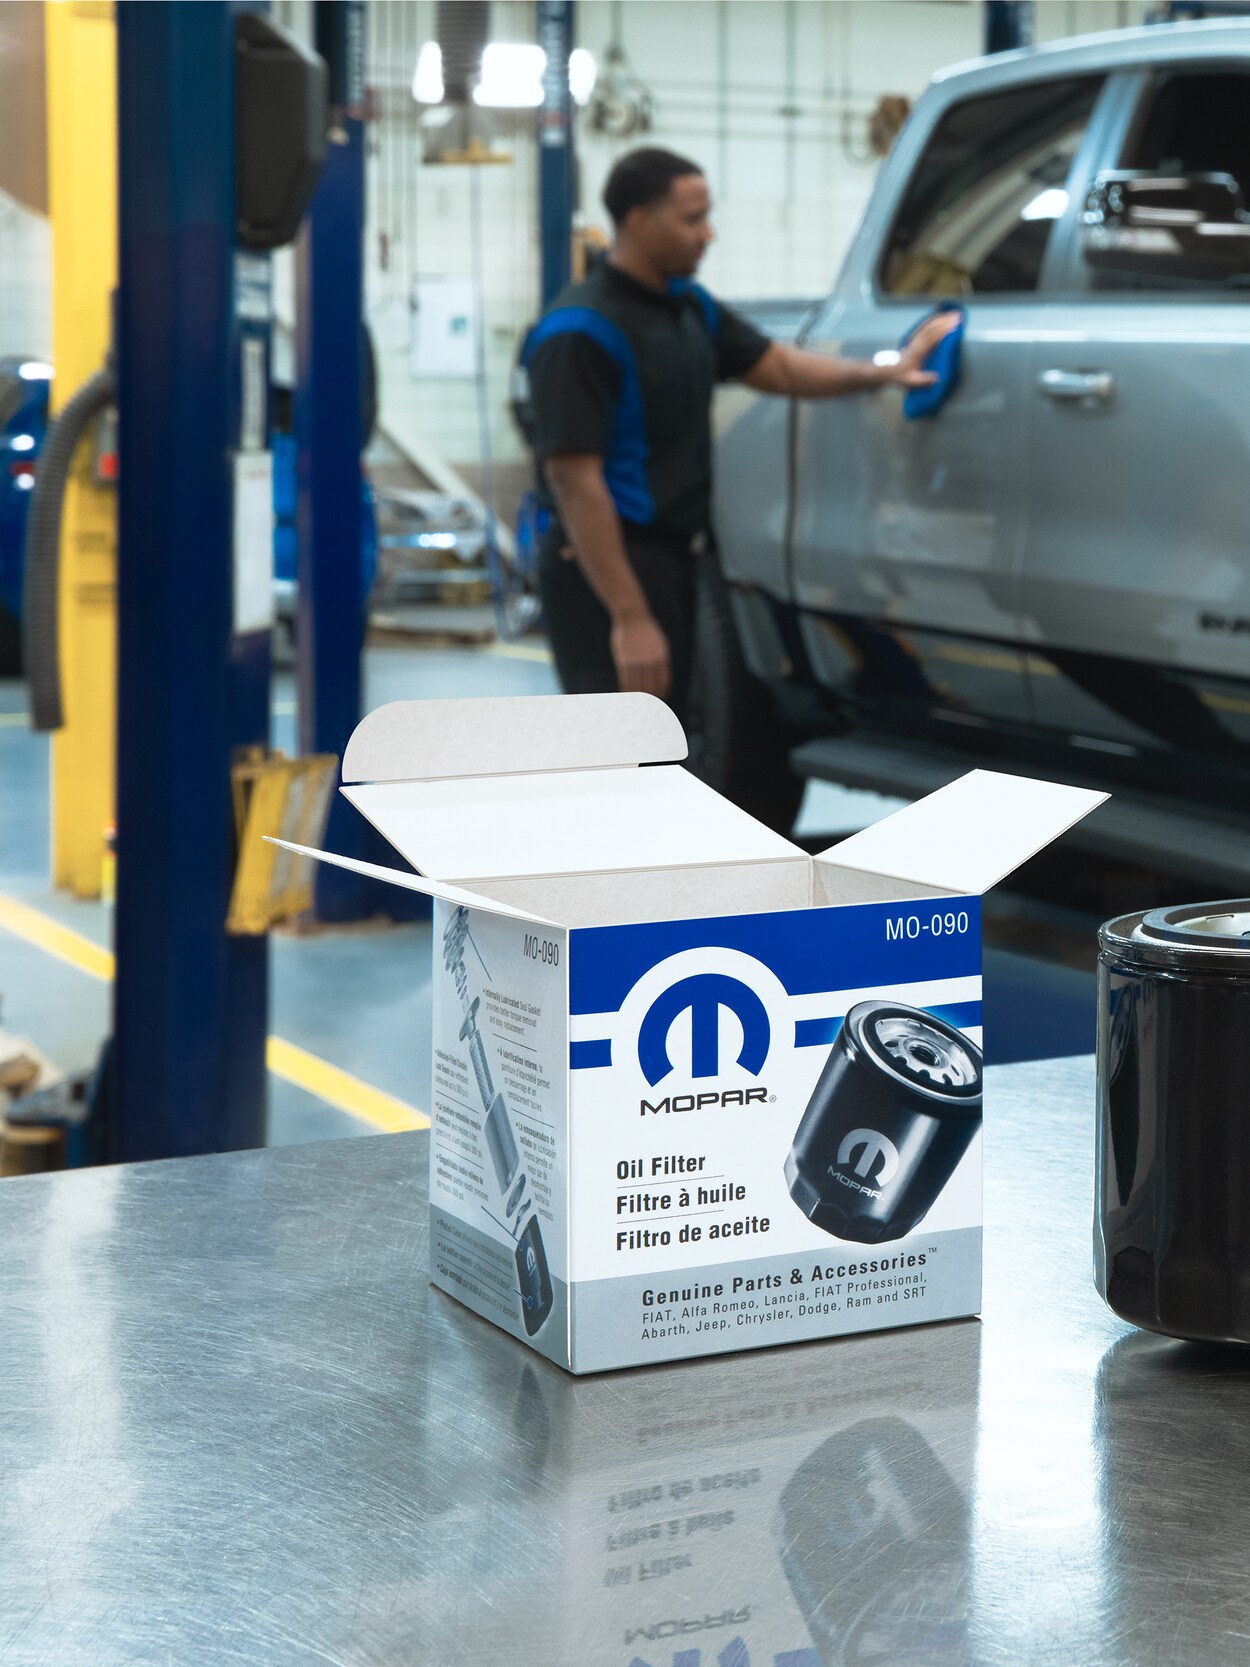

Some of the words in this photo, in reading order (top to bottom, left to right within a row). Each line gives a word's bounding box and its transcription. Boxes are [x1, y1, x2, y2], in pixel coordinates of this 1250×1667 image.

[886, 911, 969, 941] MO-090
[523, 934, 559, 966] MO-090
[616, 1159, 643, 1180] Oil
[651, 1155, 706, 1176] Filter
[616, 1194, 671, 1215] Filtre
[678, 1188, 690, 1208] à
[697, 1183, 746, 1205] huile
[616, 1229, 671, 1251] Filtro
[678, 1224, 702, 1243] de
[708, 1216, 770, 1240] aceite
[641, 1283, 724, 1306] Genuine
[732, 1273, 782, 1293] Parts
[789, 1268, 803, 1284] &
[642, 1309, 676, 1324] FIAT,
[681, 1305, 707, 1319] Alfa
[713, 1301, 759, 1314] Romeo,
[764, 1292, 810, 1307] Lancia,
[814, 1284, 842, 1299] FIAT
[847, 1271, 928, 1293] Professional,
[641, 1325, 690, 1343] Abarth,
[695, 1319, 731, 1335] Jeep,
[737, 1308, 794, 1328] Chrysler,
[799, 1300, 841, 1317] Dodge,
[847, 1297, 872, 1308] Ram
[877, 1292, 898, 1304] and
[903, 1286, 927, 1300] SRT
